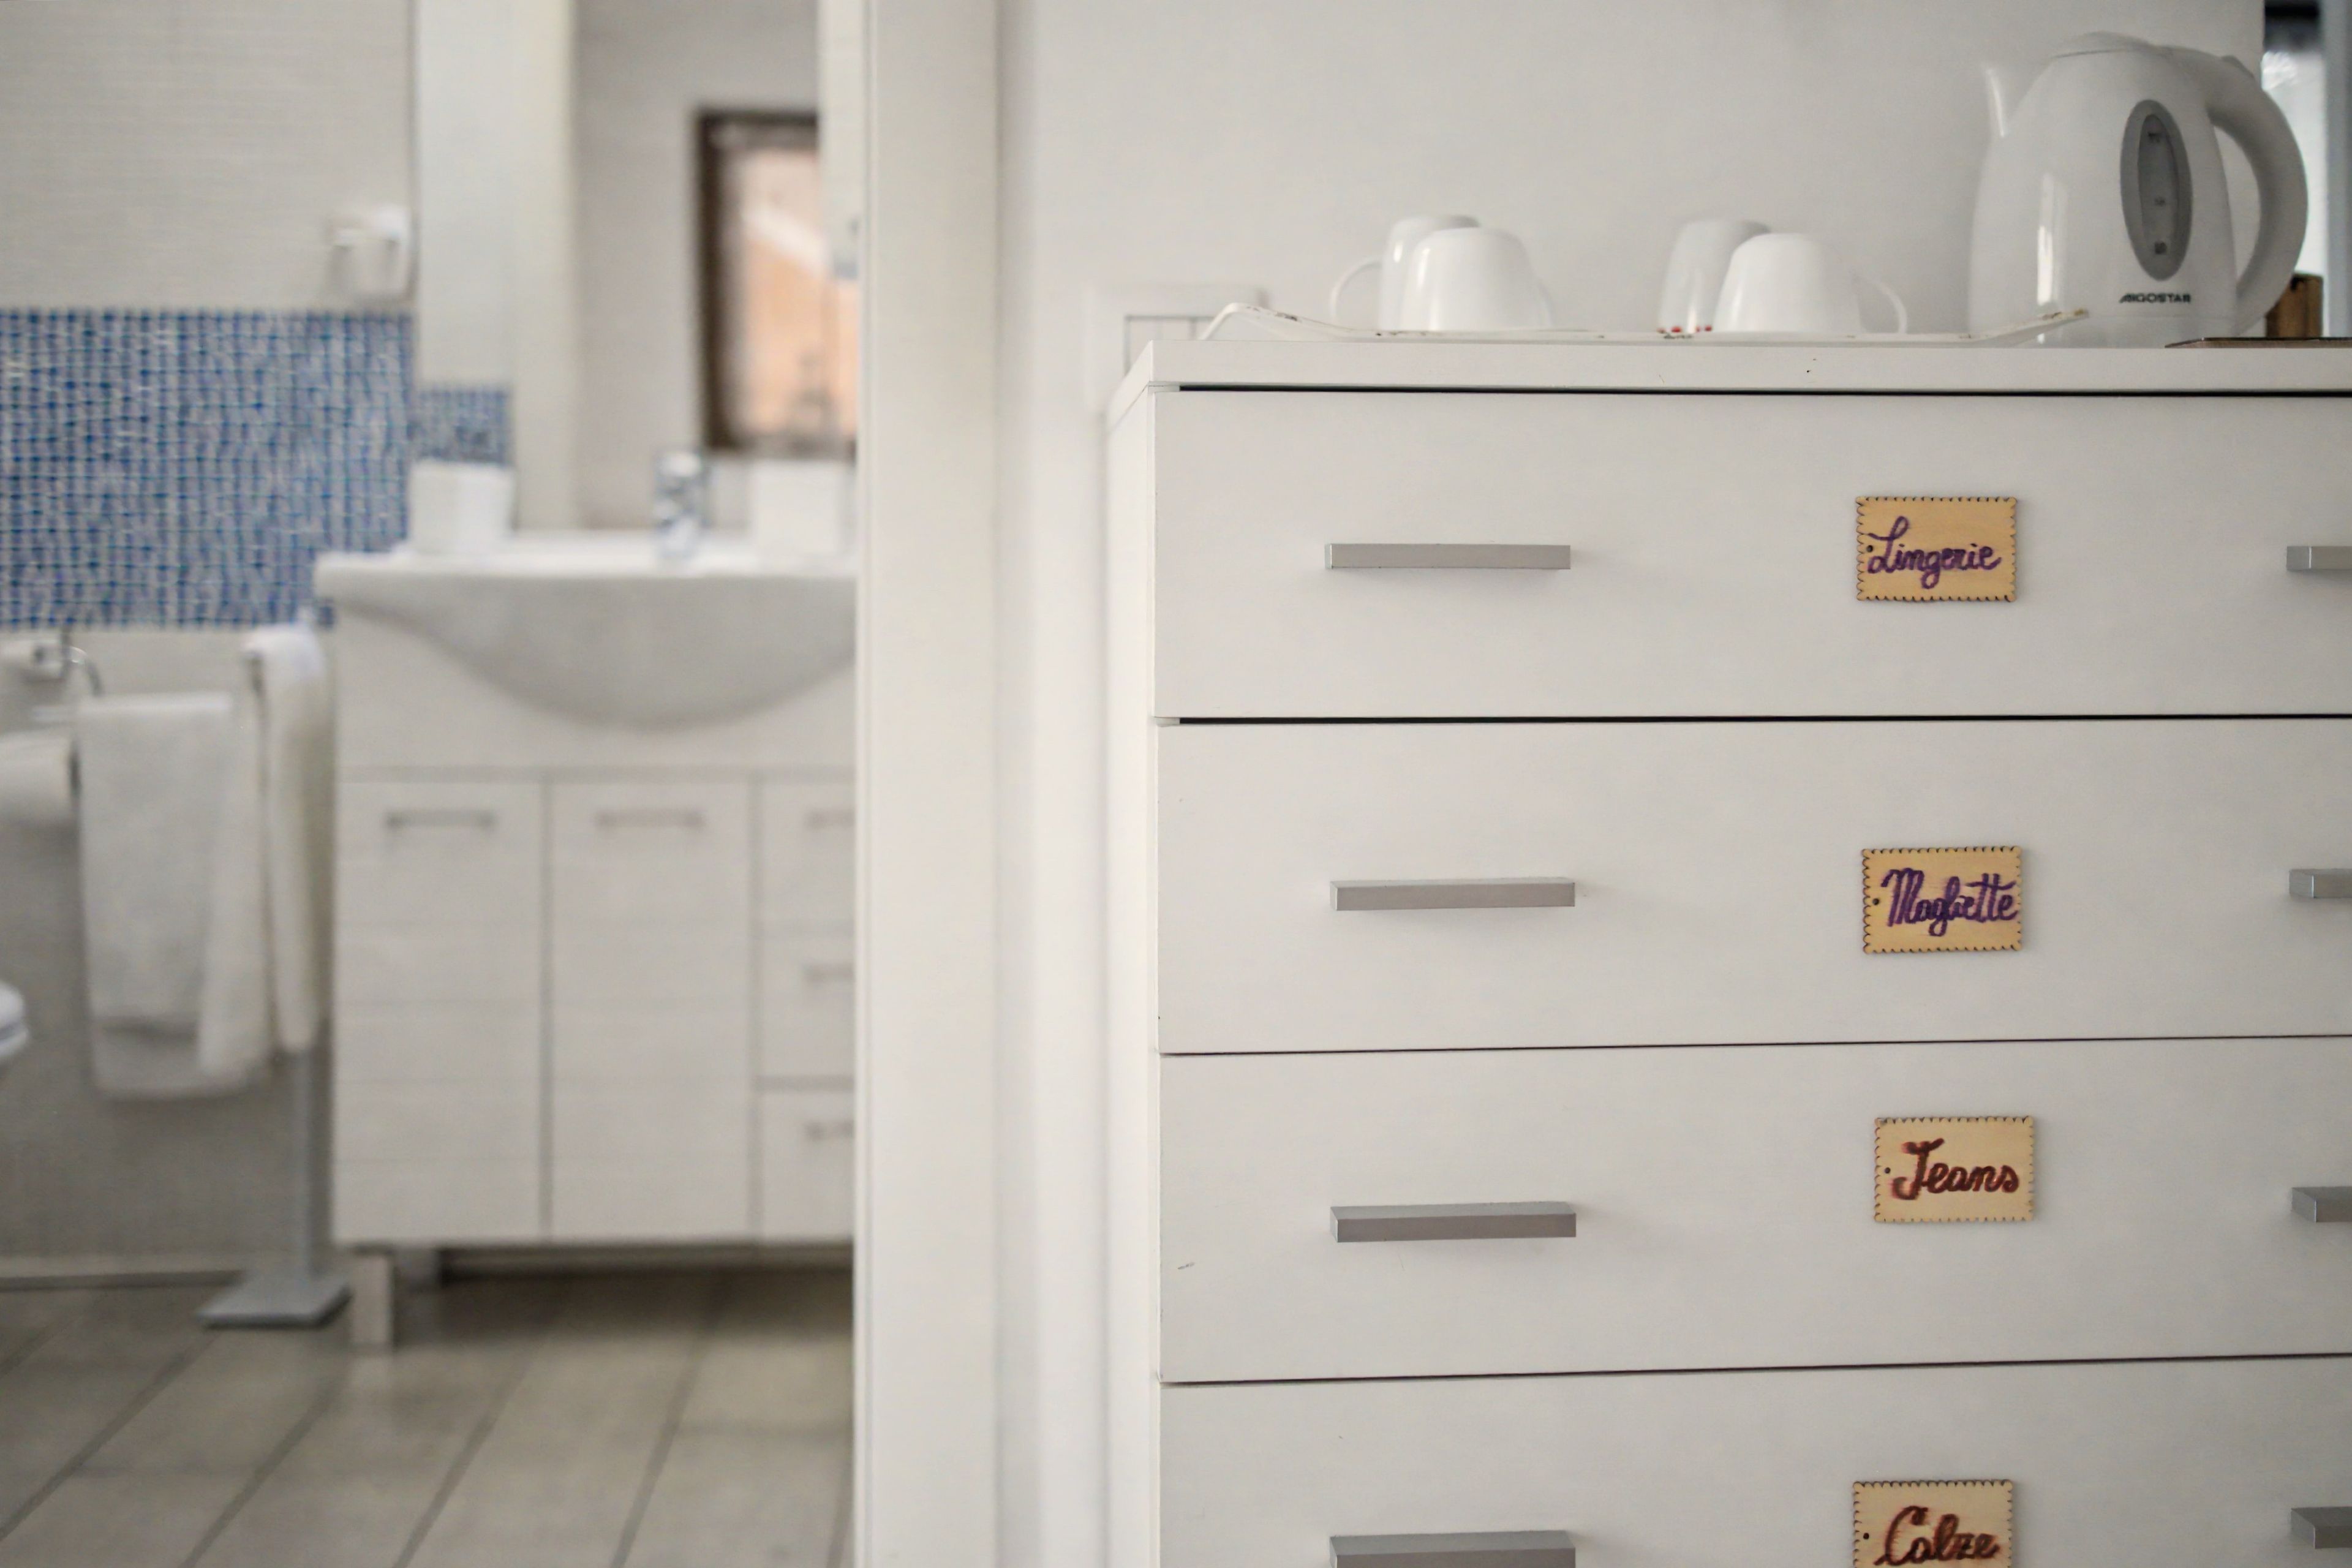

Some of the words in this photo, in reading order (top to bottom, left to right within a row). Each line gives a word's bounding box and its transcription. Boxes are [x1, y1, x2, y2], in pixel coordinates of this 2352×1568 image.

[1868, 516, 2002, 589] Lingerie
[1880, 867, 2019, 937] Magliette
[1891, 1138, 2019, 1200] Jeans
[1873, 1506, 2000, 1566] Calze
